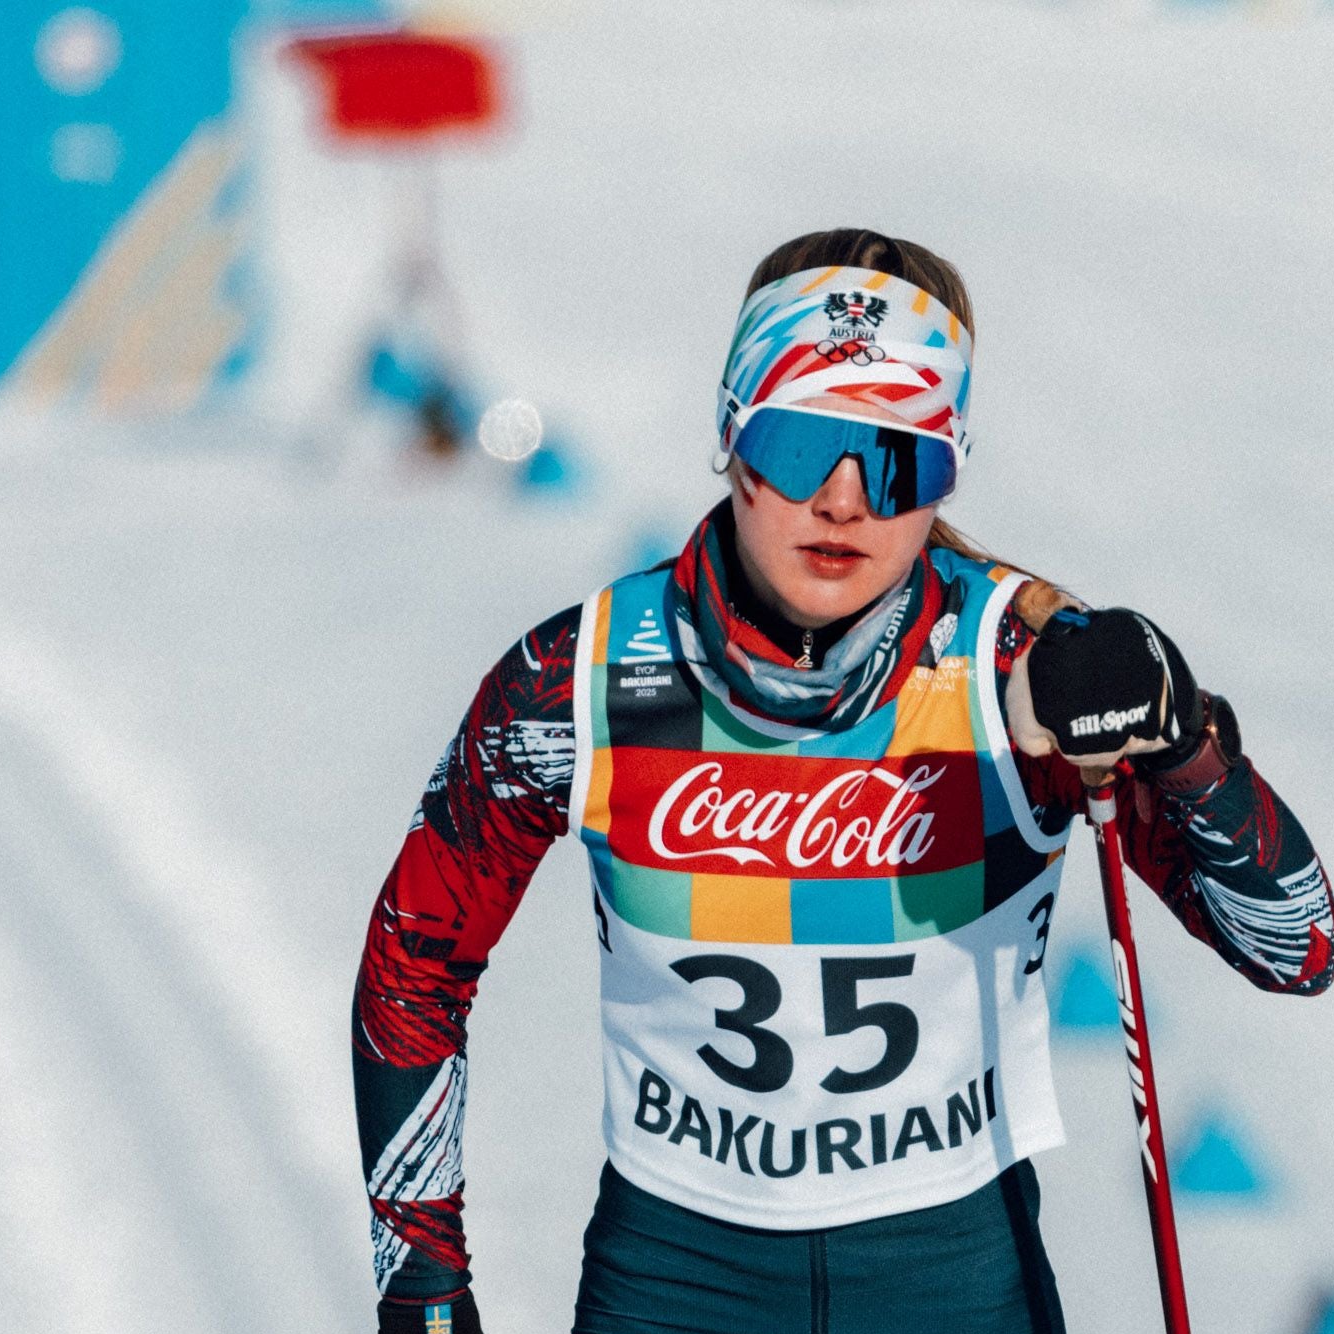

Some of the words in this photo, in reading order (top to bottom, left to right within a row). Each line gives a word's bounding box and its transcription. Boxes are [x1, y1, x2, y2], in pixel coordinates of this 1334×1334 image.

[829, 327, 876, 342] AUSTRIA
[635, 665, 657, 675] EYOF
[620, 675, 672, 688] BAKURIANI
[635, 687, 657, 697] 2025
[648, 761, 947, 868] Coca-Cola
[668, 952, 920, 1094] 35
[633, 1065, 997, 1179] BAKURIANI
